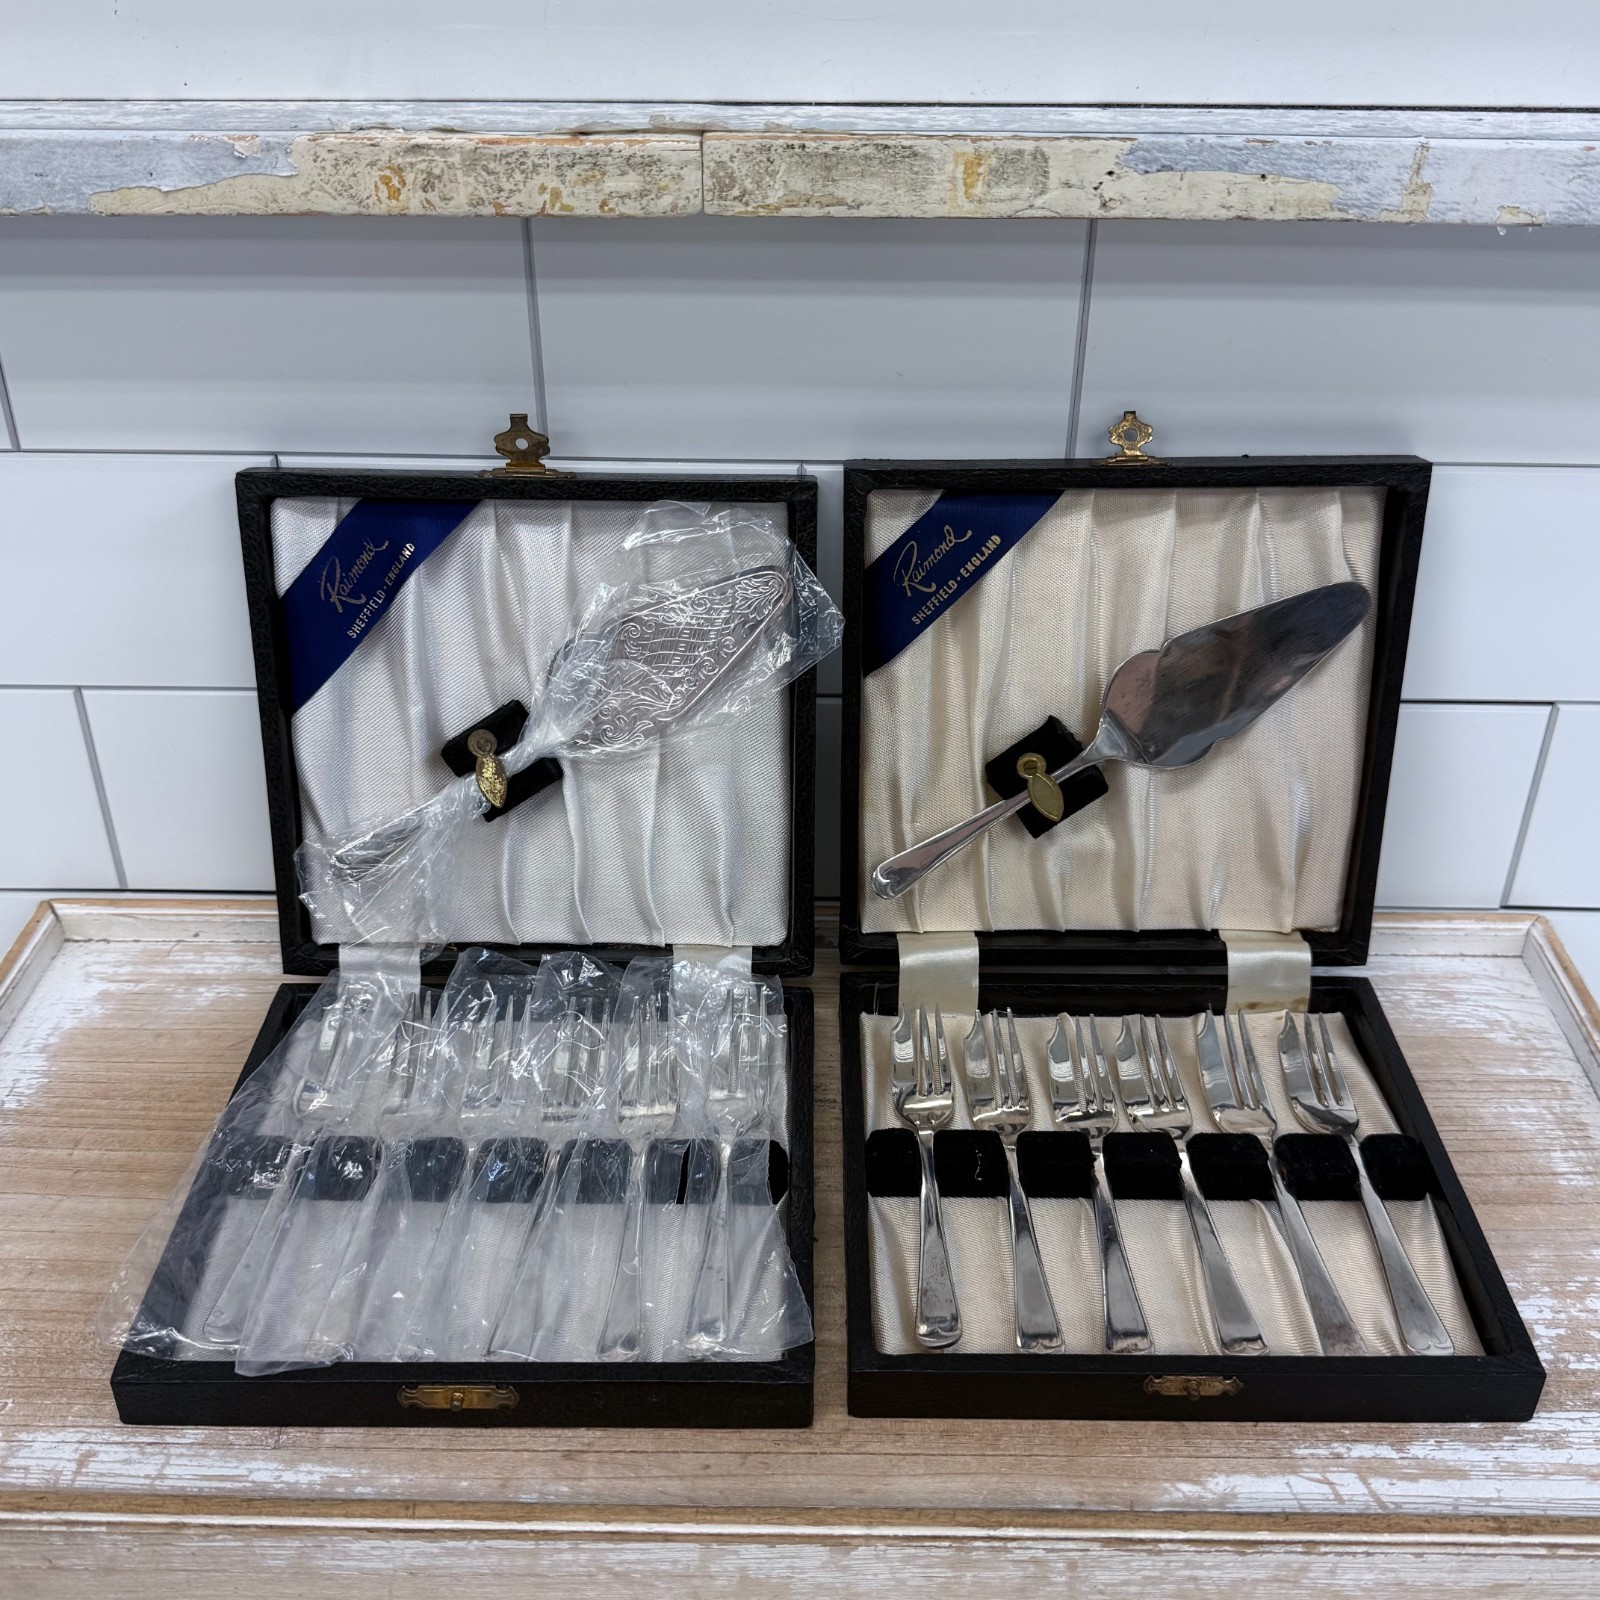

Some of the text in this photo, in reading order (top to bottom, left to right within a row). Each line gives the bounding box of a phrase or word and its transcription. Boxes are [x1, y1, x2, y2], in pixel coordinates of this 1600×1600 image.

[347, 543, 416, 639] SHEFFIELD ENGLAND
[893, 525, 973, 597] Raimond
[911, 534, 1002, 625] SHEFFIELD ENGLAND
